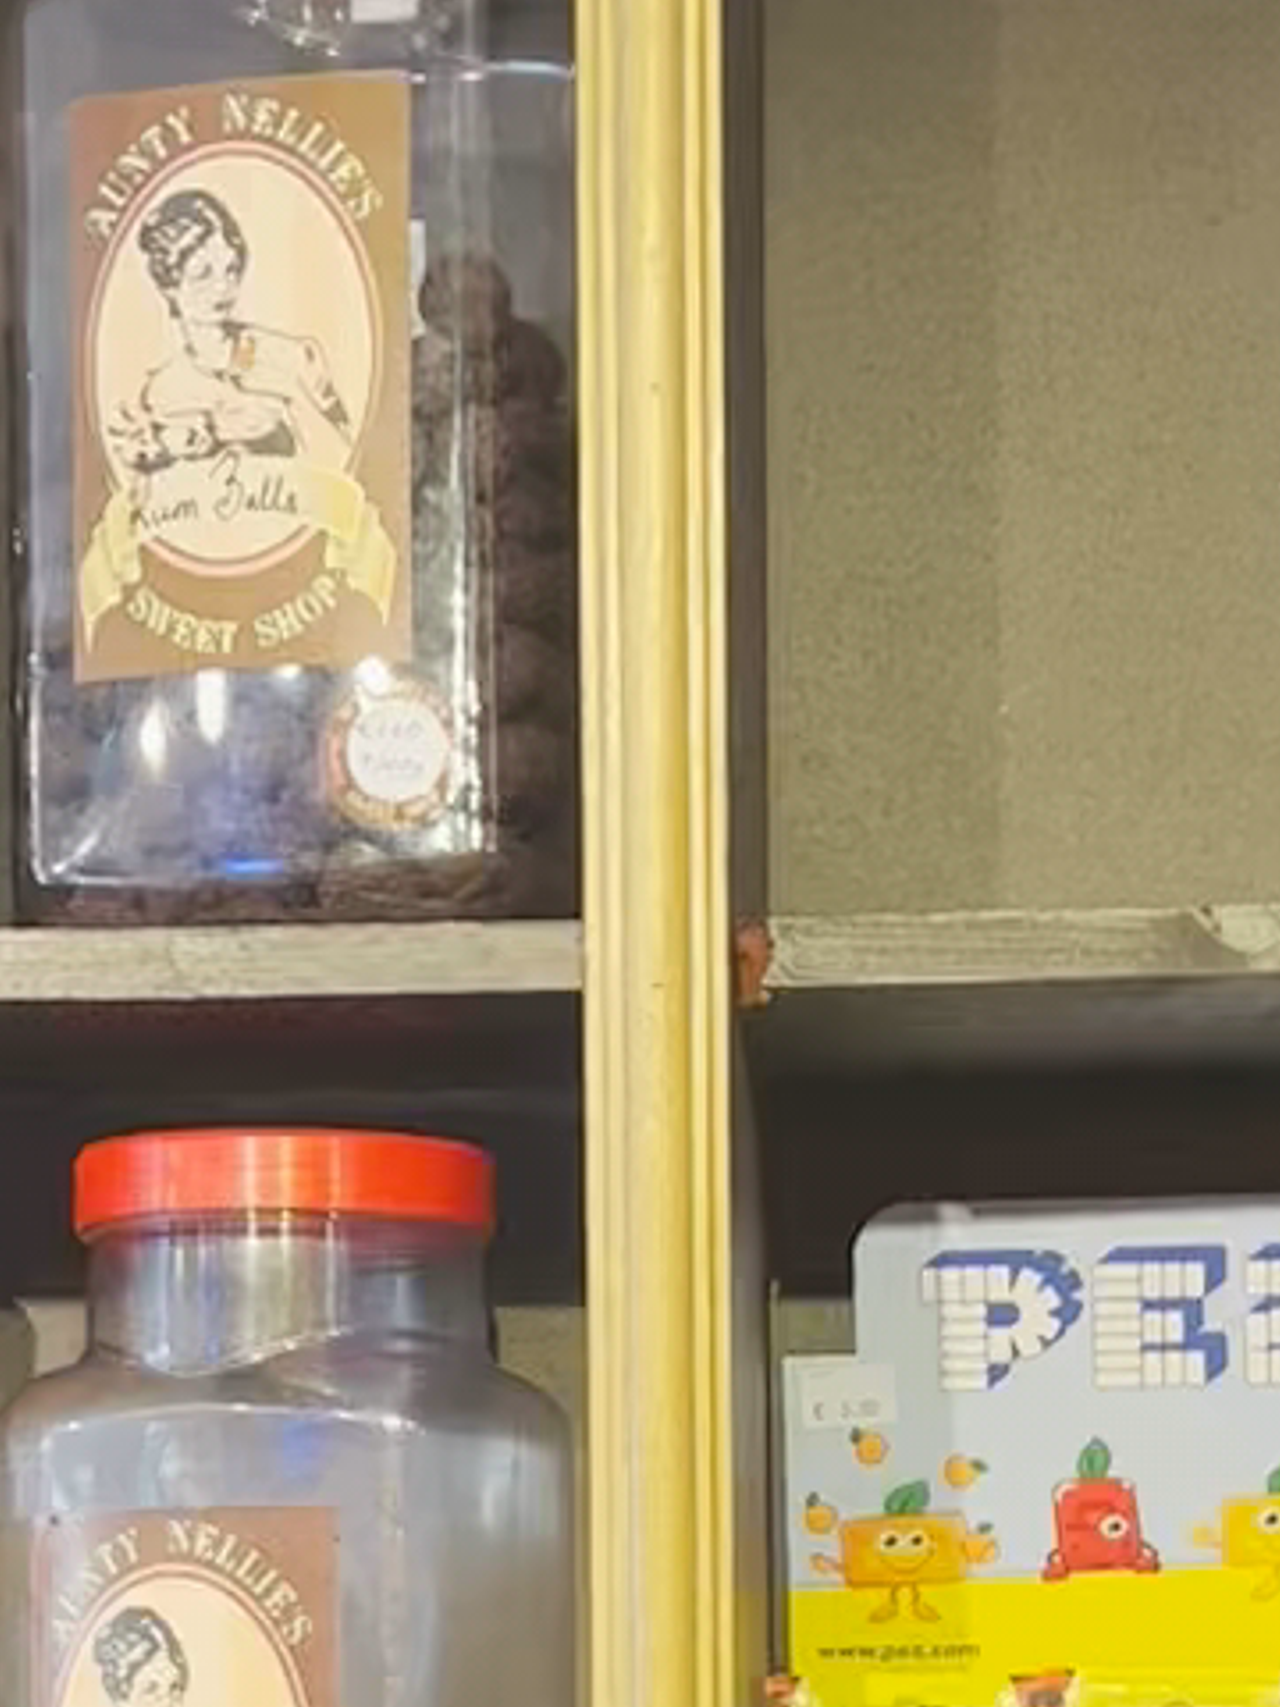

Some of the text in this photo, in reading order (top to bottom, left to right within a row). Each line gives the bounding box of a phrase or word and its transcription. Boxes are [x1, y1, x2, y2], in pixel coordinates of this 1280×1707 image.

[85, 104, 193, 239] AUNTY
[128, 576, 340, 655] SWEET SHOP
